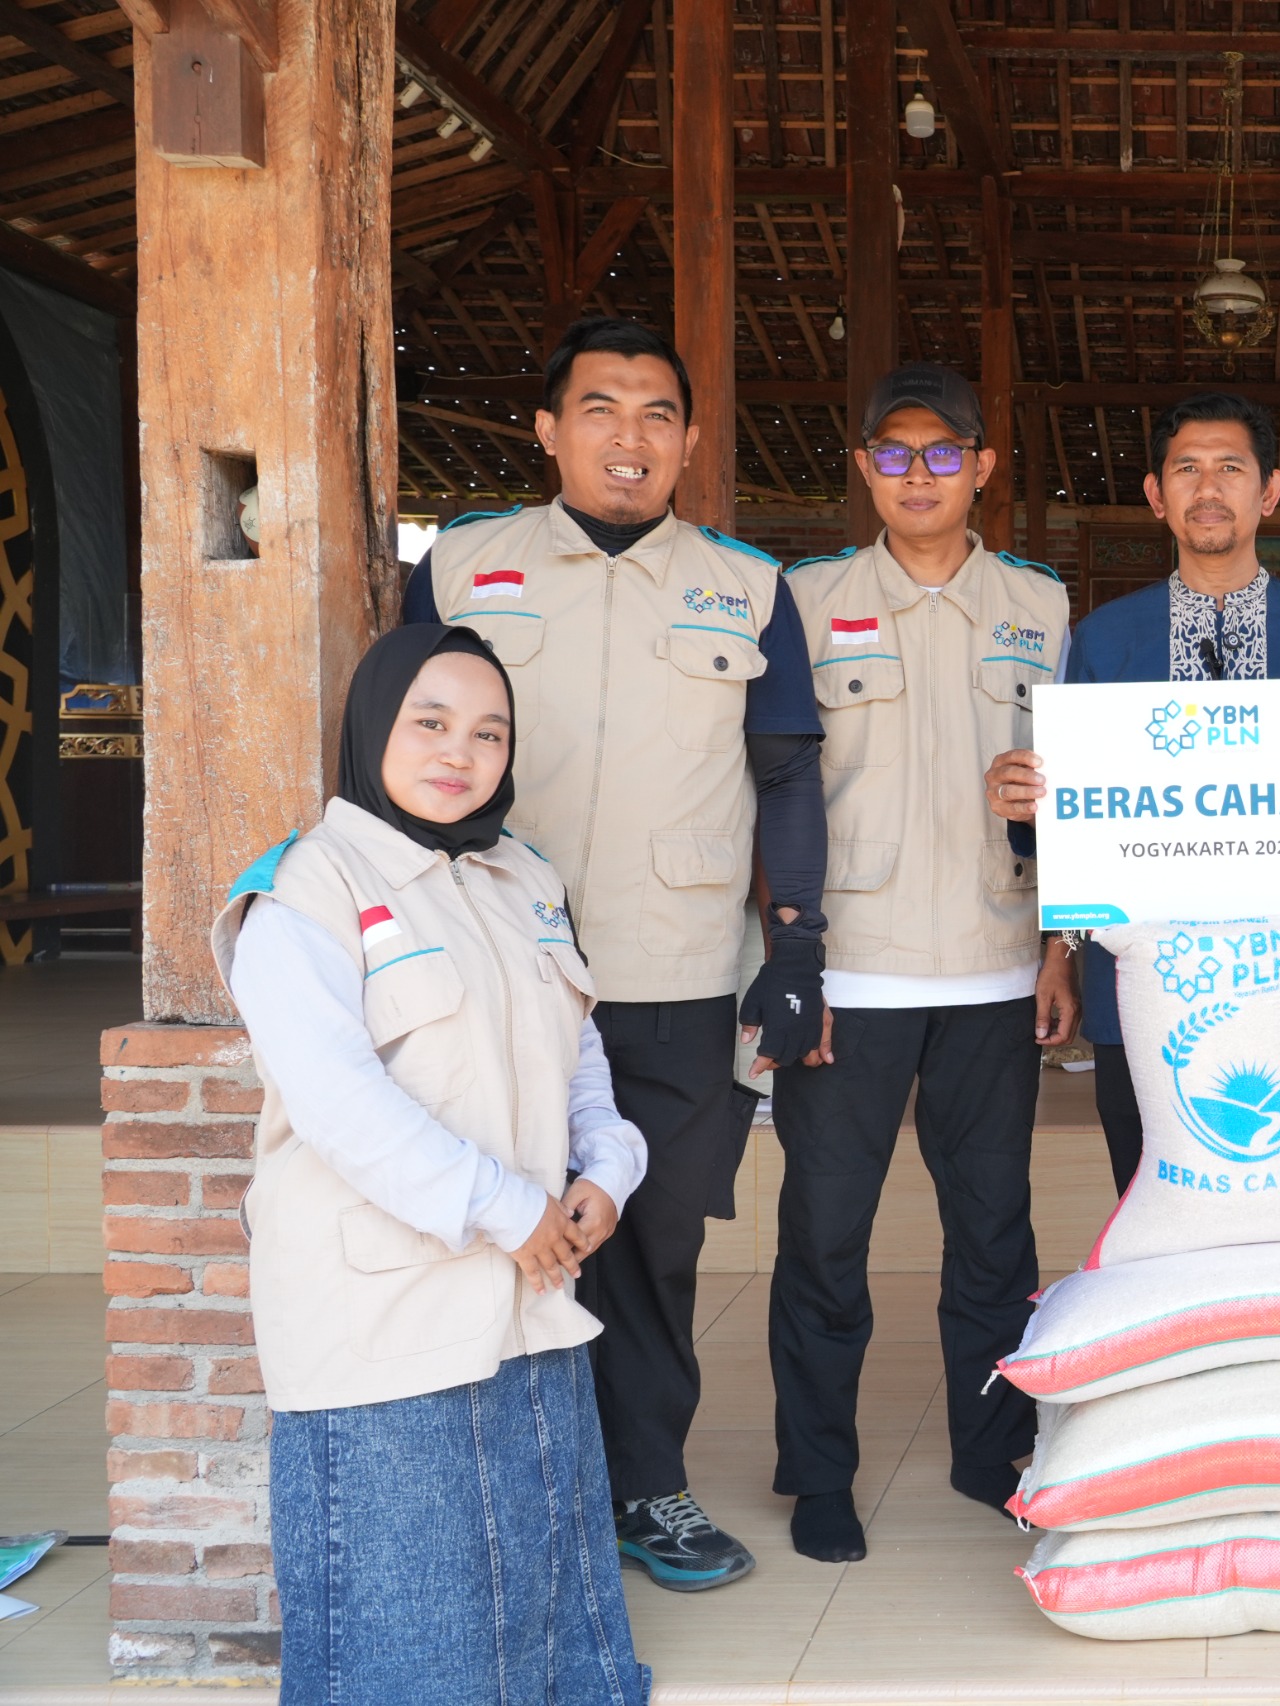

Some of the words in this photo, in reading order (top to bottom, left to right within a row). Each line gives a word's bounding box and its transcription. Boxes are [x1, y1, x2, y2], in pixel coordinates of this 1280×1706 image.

[715, 592, 748, 609] YBM
[718, 602, 748, 620] PLN
[1017, 627, 1045, 641] YBM
[1019, 638, 1044, 653] PLN
[1202, 704, 1259, 725] YBM
[1207, 725, 1260, 746] PLN
[1054, 784, 1185, 820] BERAS
[1119, 841, 1250, 858] YOGYAKARTA
[1052, 912, 1110, 921] www.ybmpln.org
[1157, 1158, 1232, 1194] BERAS
